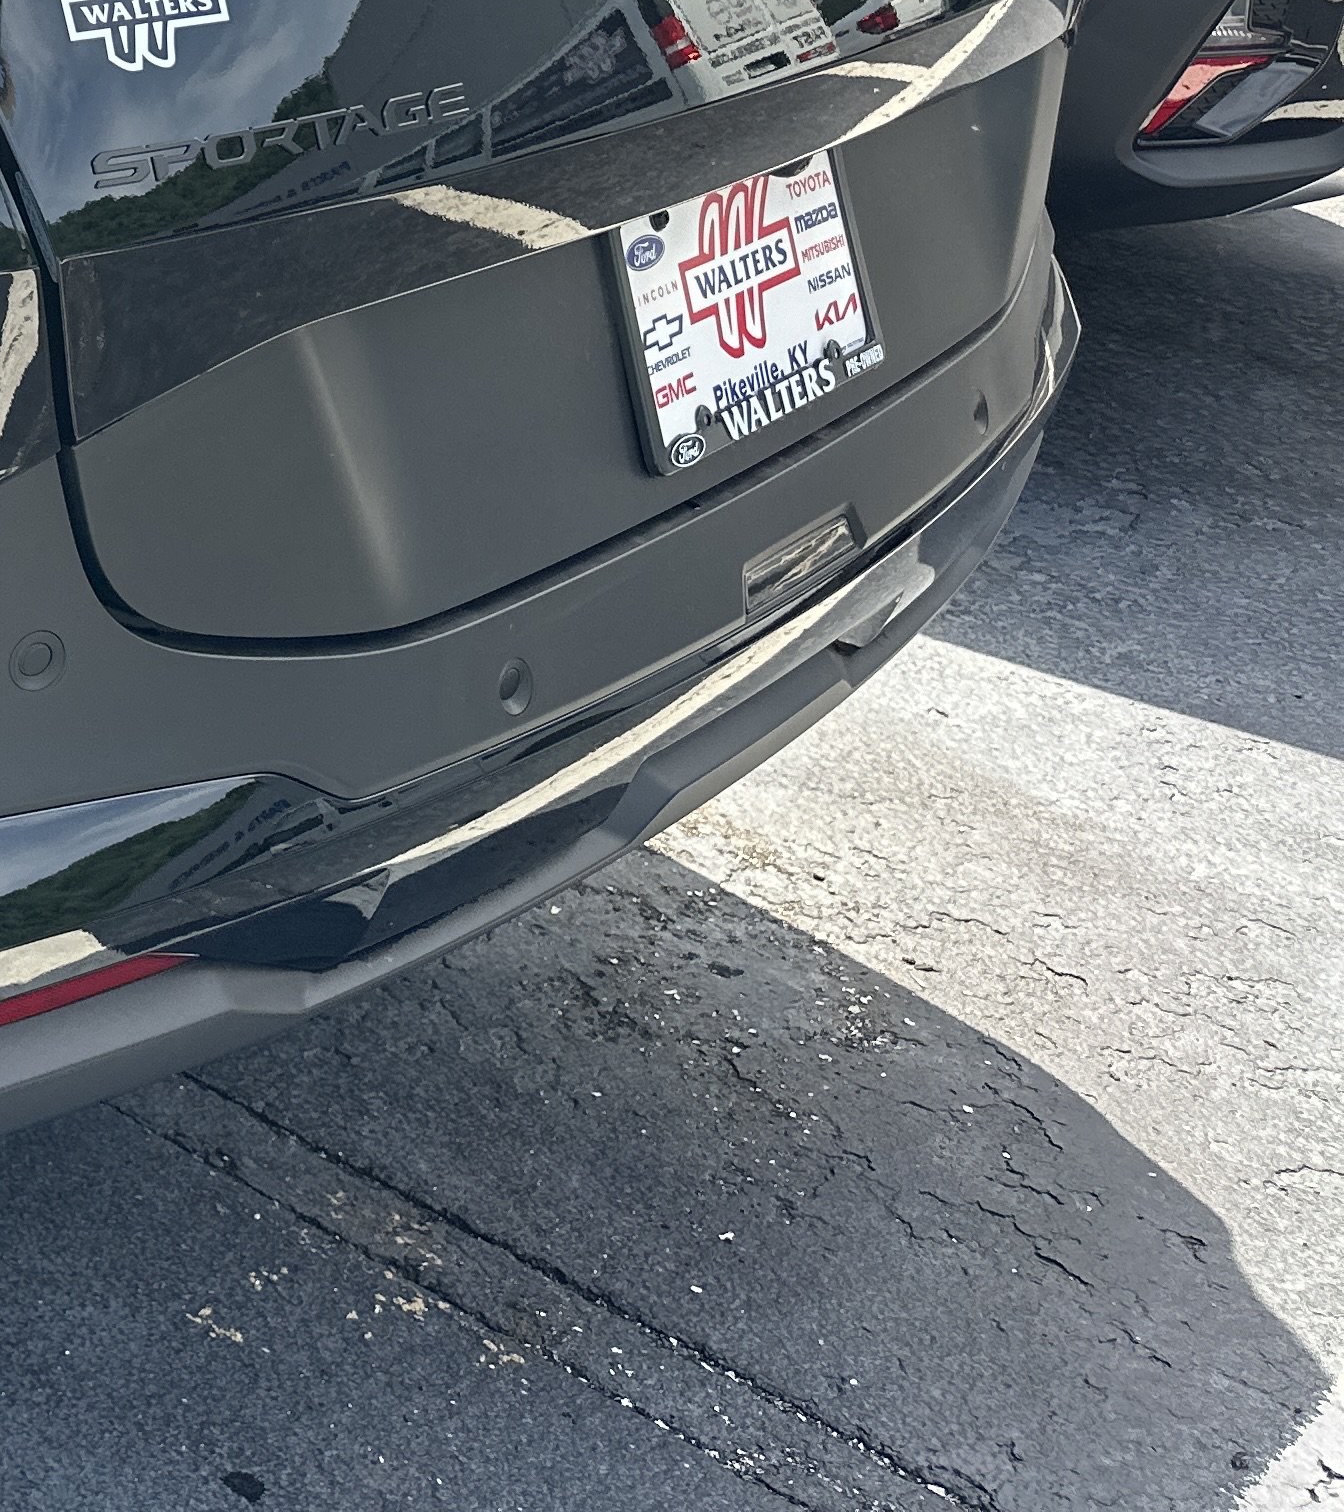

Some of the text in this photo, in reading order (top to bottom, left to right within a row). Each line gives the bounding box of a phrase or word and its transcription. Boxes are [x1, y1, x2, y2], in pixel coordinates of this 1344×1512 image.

[91, 82, 470, 190] SPORTAGE
[786, 170, 832, 200] TOYOTA
[632, 240, 658, 268] Ford
[801, 234, 847, 264] MITSUBISHI
[694, 238, 788, 299] WALTERS
[807, 263, 853, 294] NISSAN
[636, 280, 678, 307] INCOLN
[787, 340, 811, 370] KY
[655, 372, 697, 409] GMC
[721, 358, 836, 441] WALTERS
[678, 440, 701, 464] Ford
